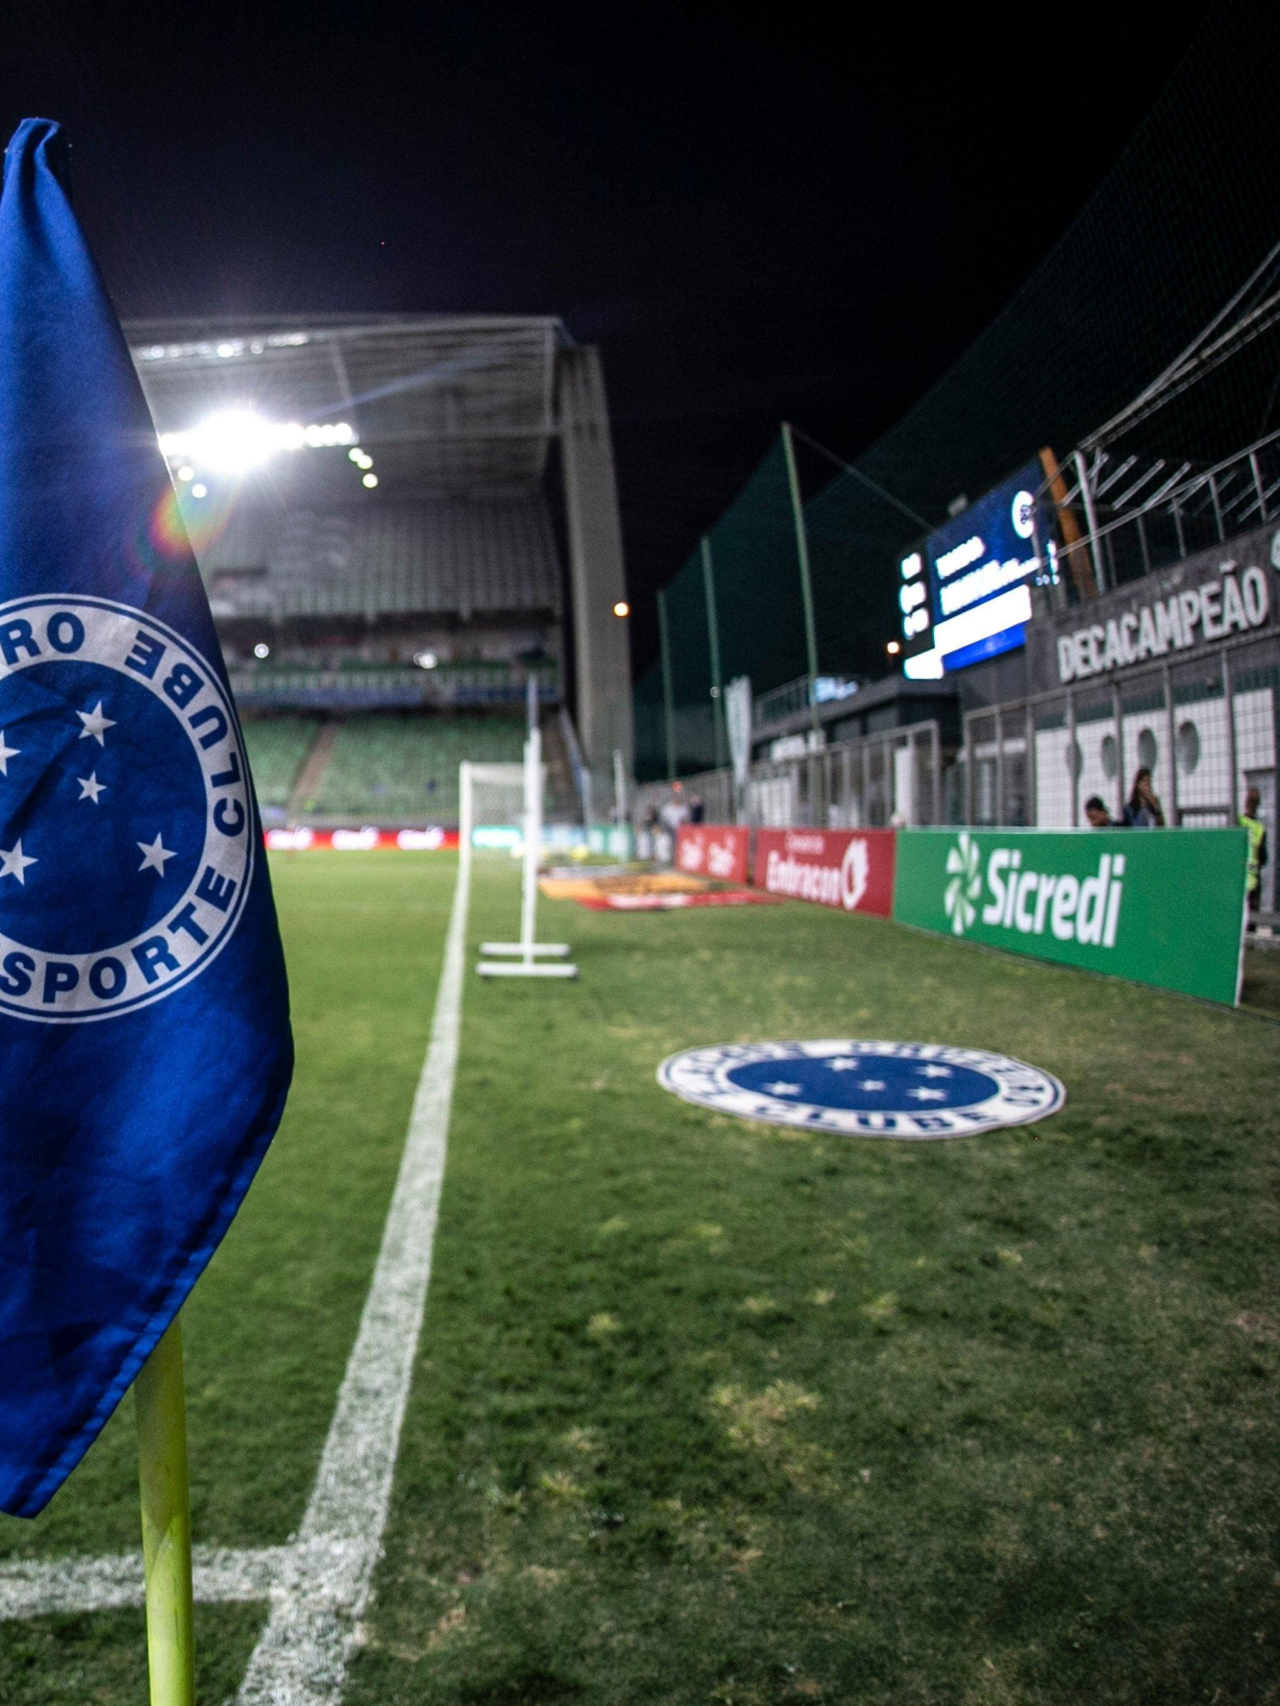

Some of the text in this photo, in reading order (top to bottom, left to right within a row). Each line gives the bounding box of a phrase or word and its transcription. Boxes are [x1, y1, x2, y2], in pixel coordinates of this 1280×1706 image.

[1057, 559, 1269, 683] DECACAMPEÃO
[123, 630, 246, 838] CLUBE
[982, 848, 1126, 949] Sicredi
